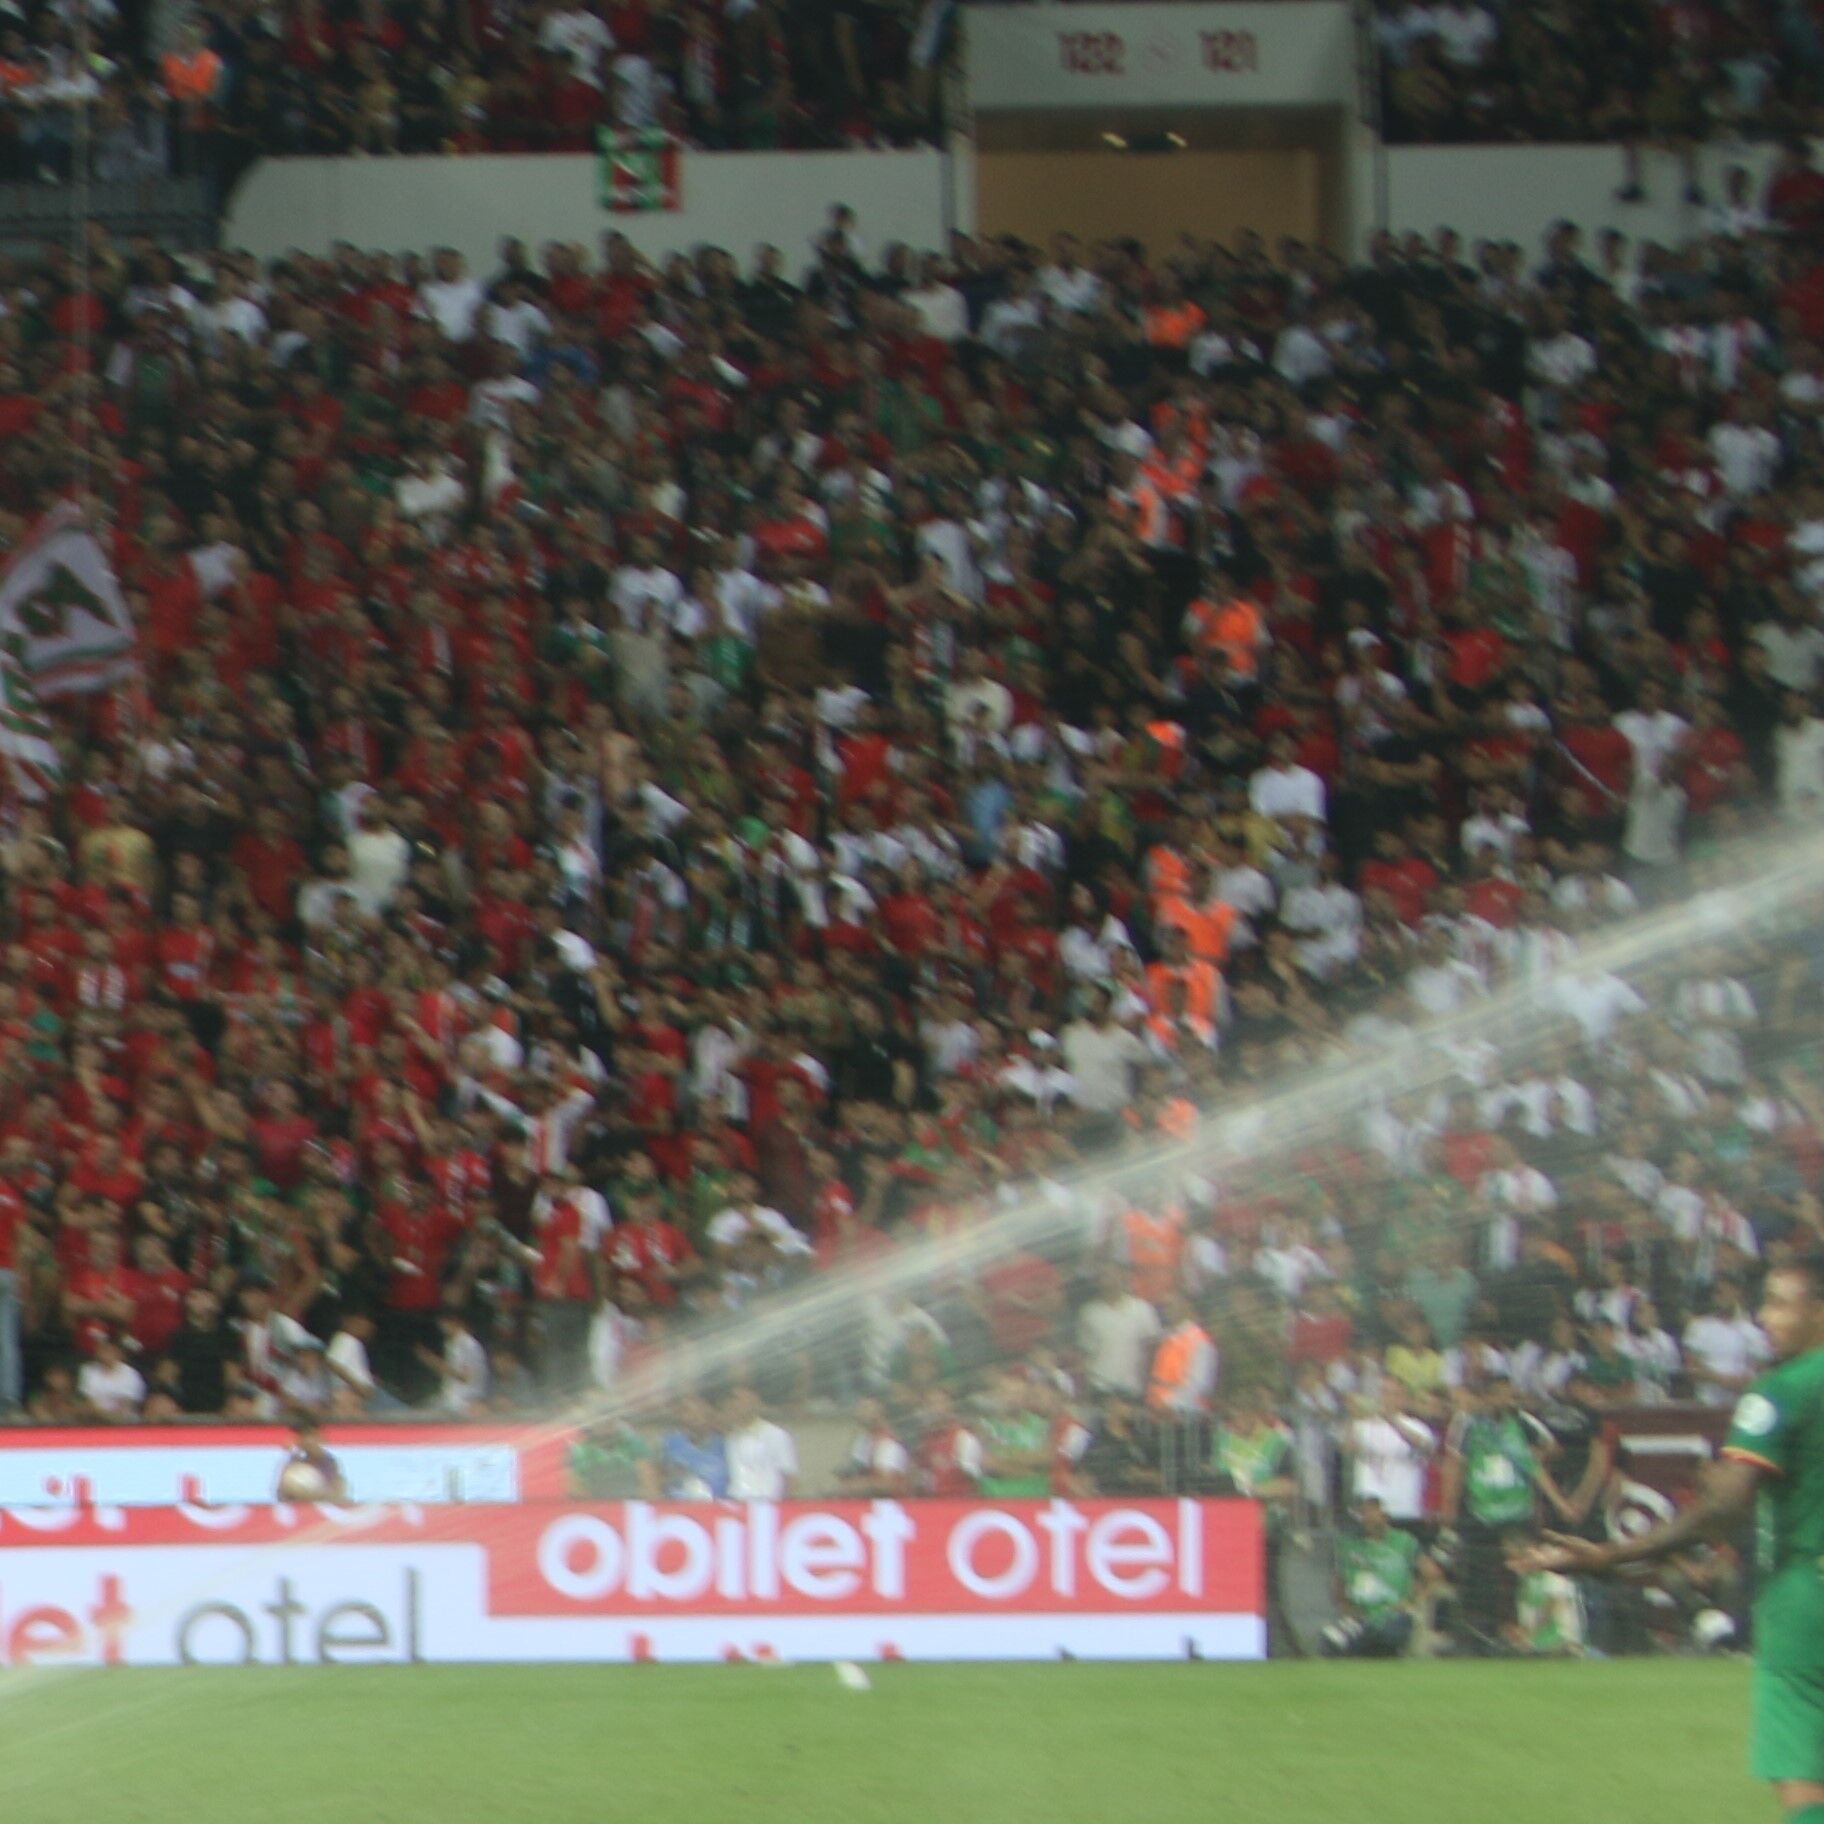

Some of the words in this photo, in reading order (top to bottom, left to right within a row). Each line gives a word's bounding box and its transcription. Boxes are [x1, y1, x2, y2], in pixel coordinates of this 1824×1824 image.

[536, 1498, 915, 1600] obilet
[946, 1498, 1204, 1600] otel
[177, 1566, 422, 1666] otel
